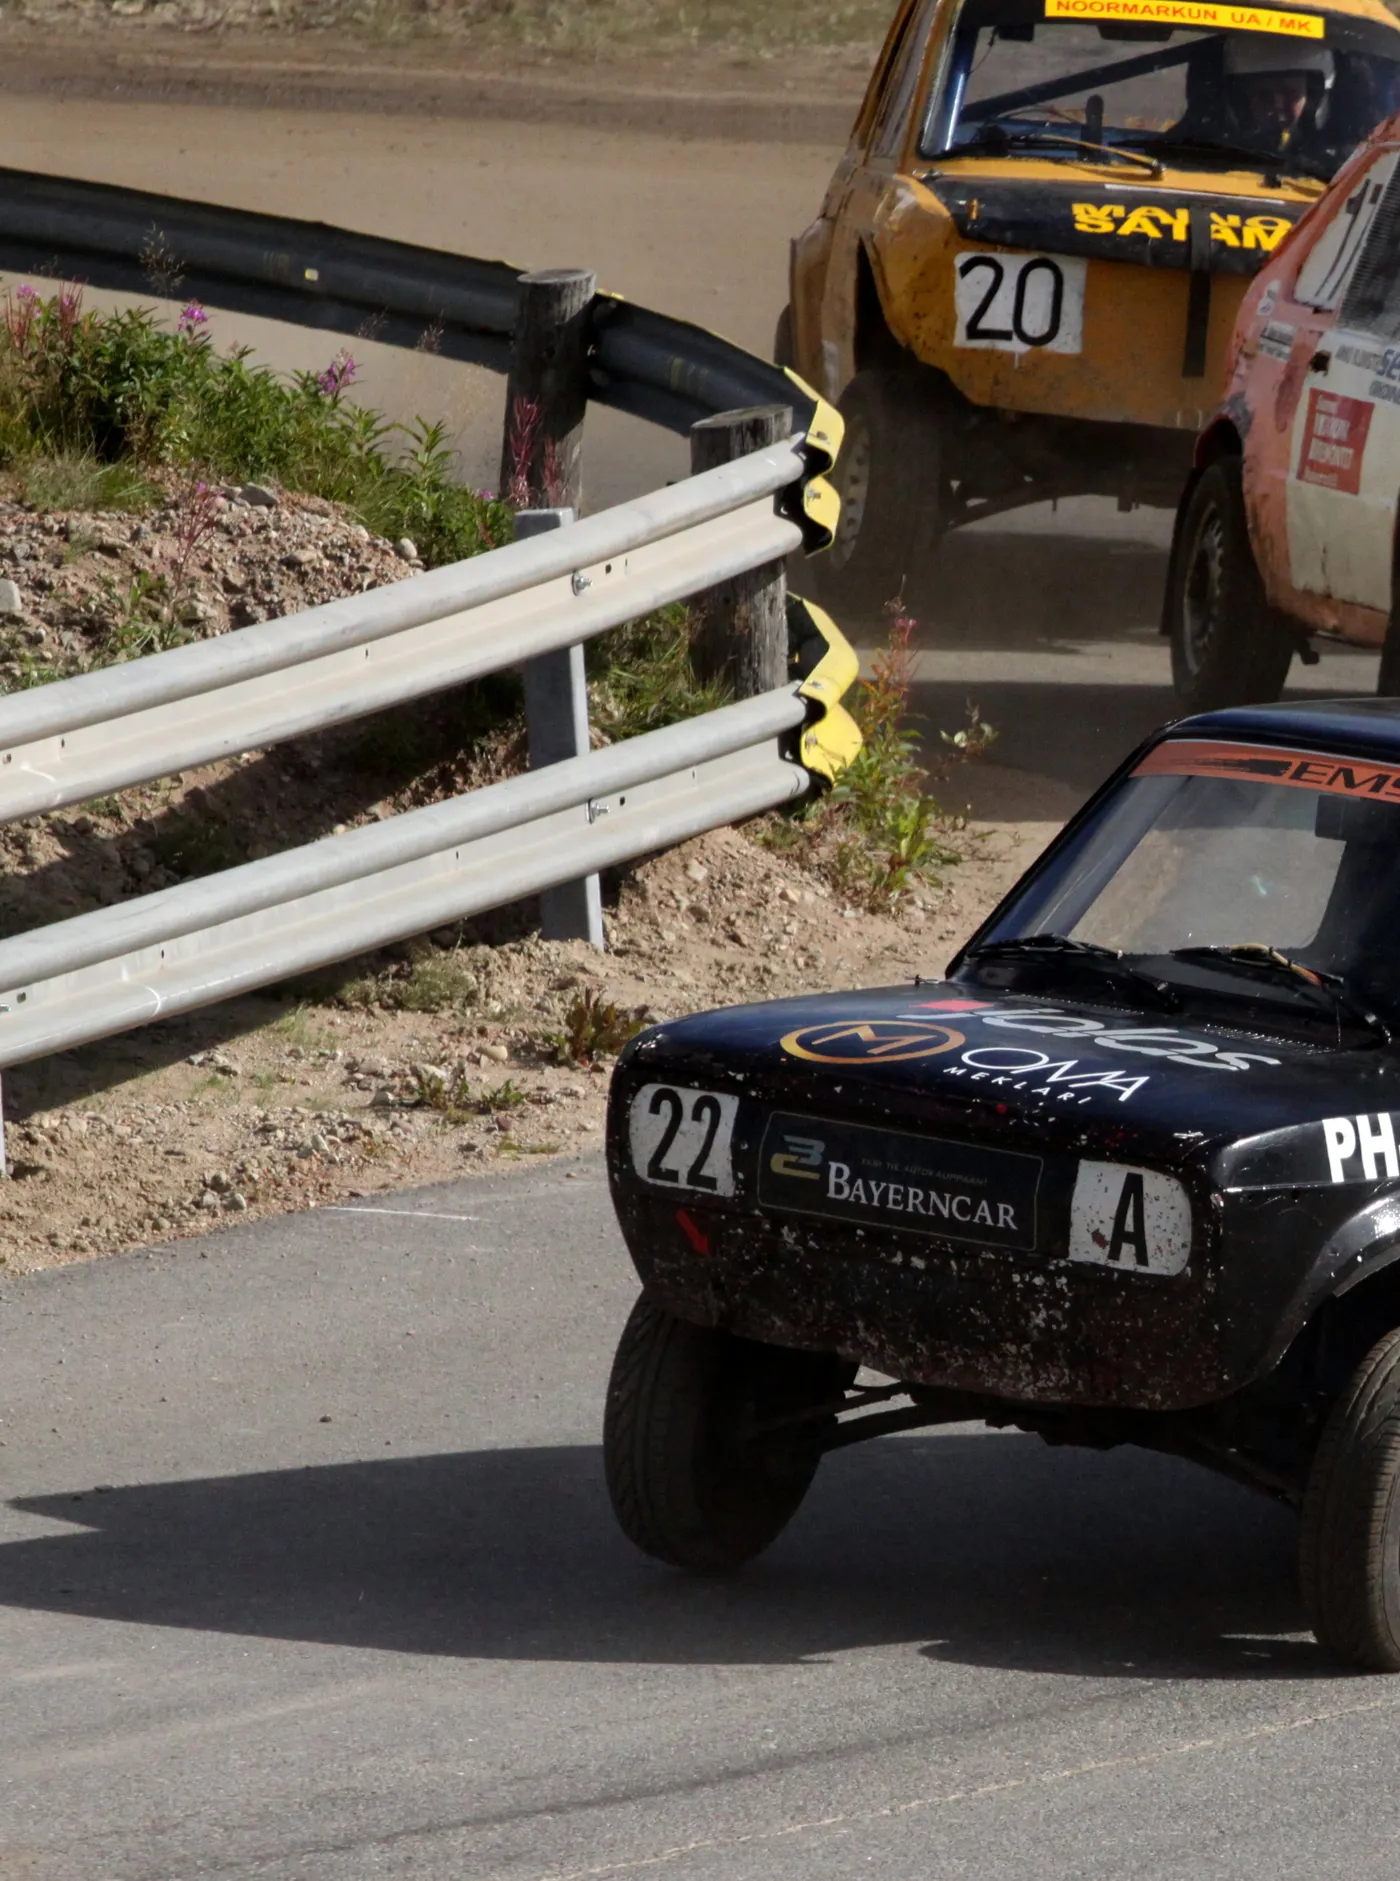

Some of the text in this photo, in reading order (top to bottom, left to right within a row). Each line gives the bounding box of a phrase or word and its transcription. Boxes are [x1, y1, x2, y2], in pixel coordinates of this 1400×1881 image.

[1056, 0, 1217, 20] NOORMARKUN
[959, 256, 1064, 347] 20
[943, 1066, 1093, 1104] MEKLARI
[960, 1047, 1150, 1102] OMA
[648, 1087, 722, 1190] 22
[826, 1161, 1019, 1230] BAYERNCAR
[1107, 1172, 1149, 1266] A
